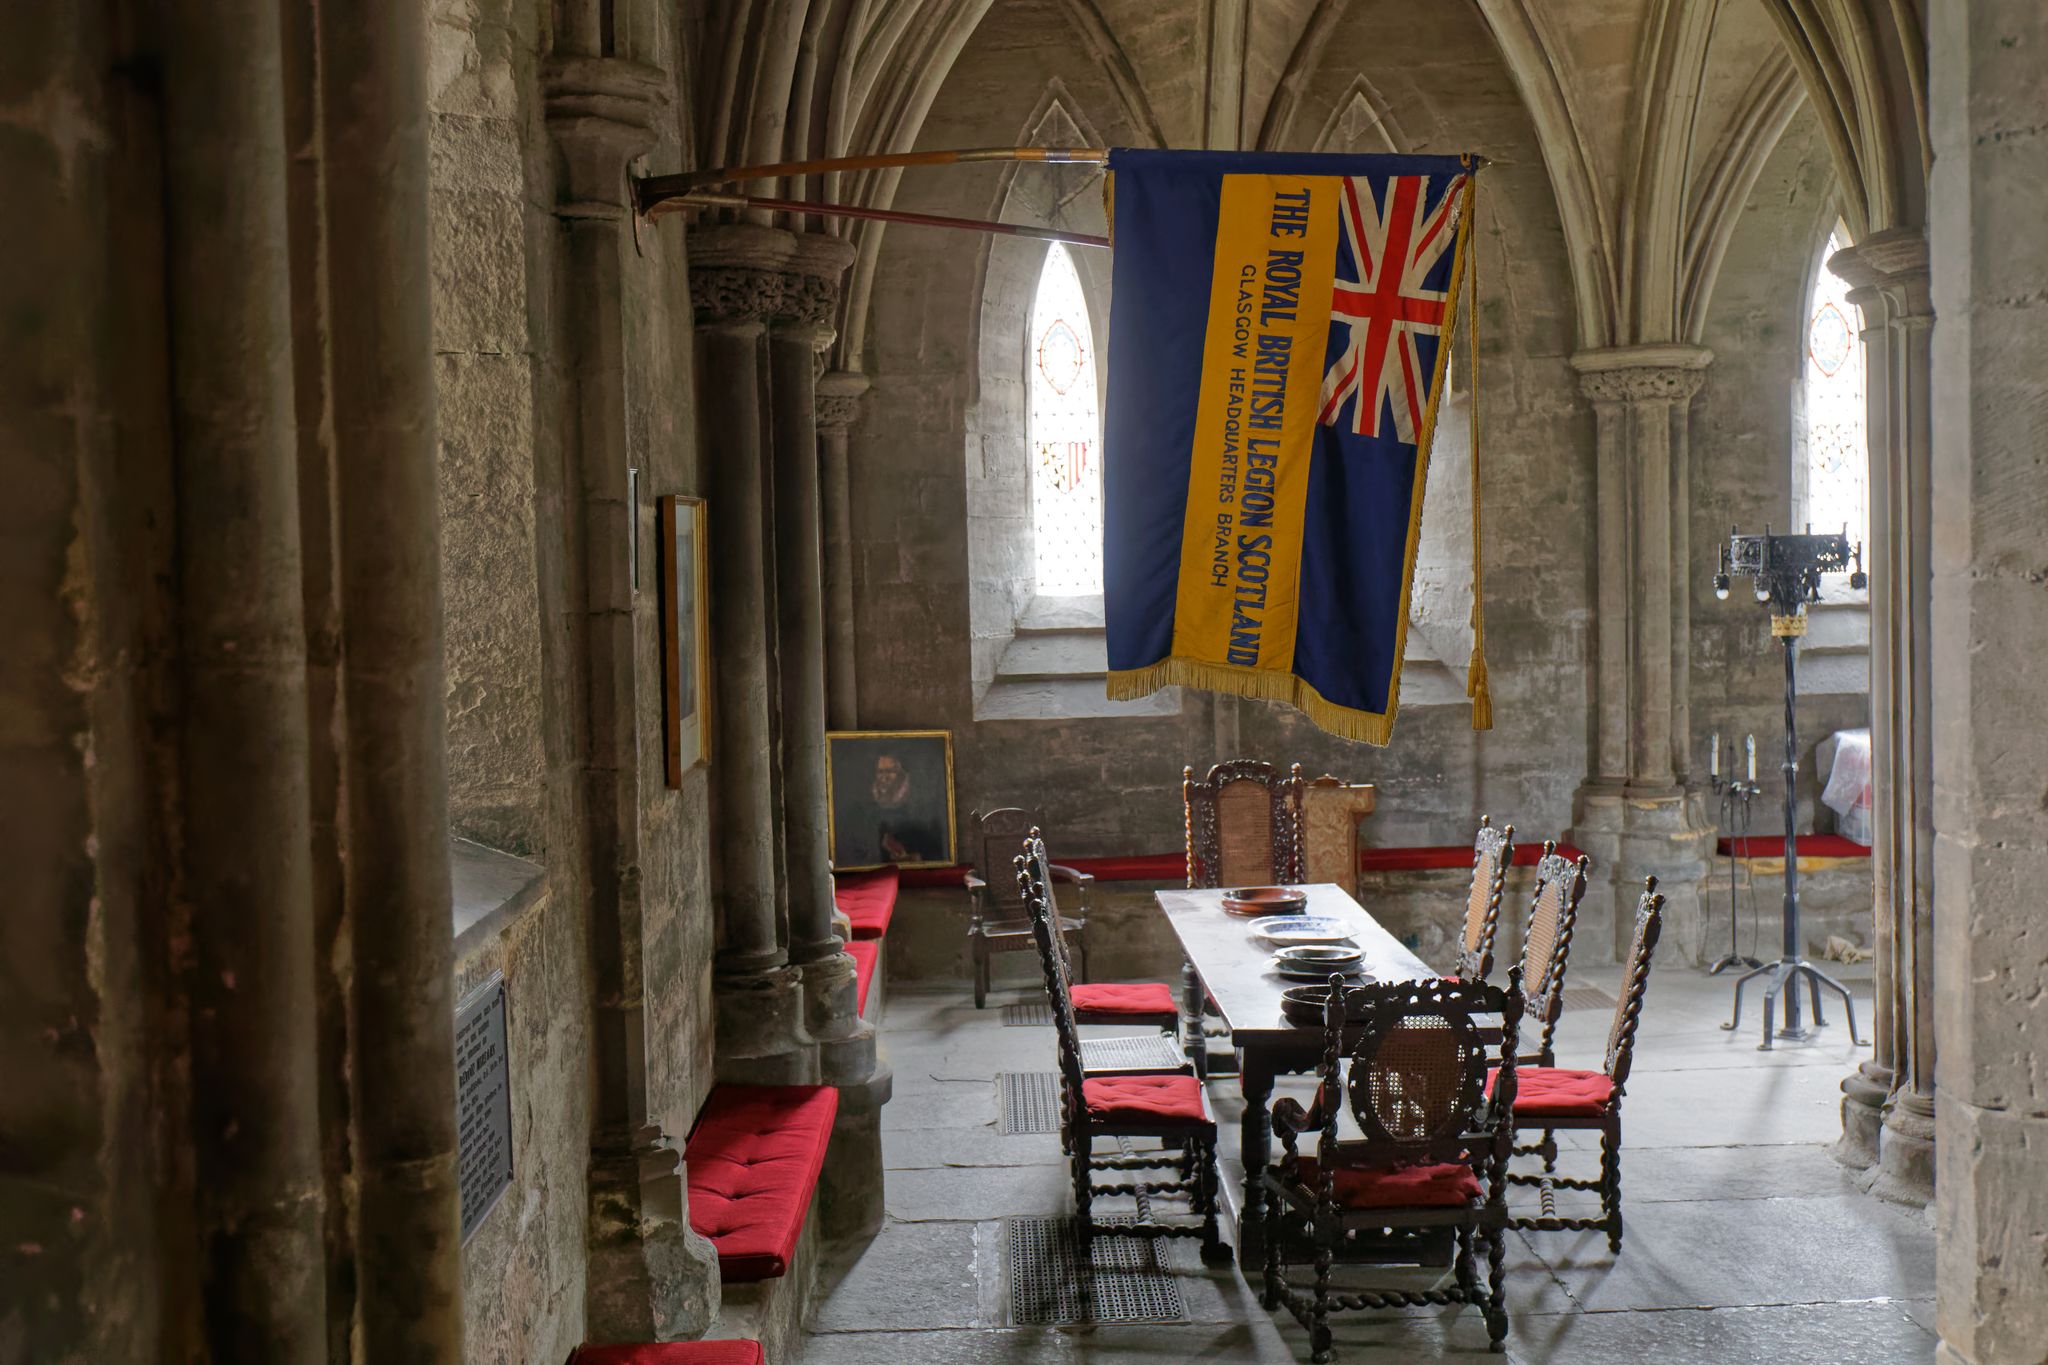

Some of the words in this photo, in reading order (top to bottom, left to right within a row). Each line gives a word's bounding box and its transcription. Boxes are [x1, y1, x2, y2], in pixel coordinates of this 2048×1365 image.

[1270, 187, 1311, 238] THE
[1232, 264, 1257, 360] GLASGOW
[1259, 249, 1304, 328] ROYAL
[1248, 333, 1293, 431] BRITISH
[1219, 368, 1246, 504] HEADQUARTERS
[1239, 437, 1280, 528] LEGION
[1210, 512, 1233, 589] BRANCH
[1227, 534, 1273, 667] SCOTLAND
